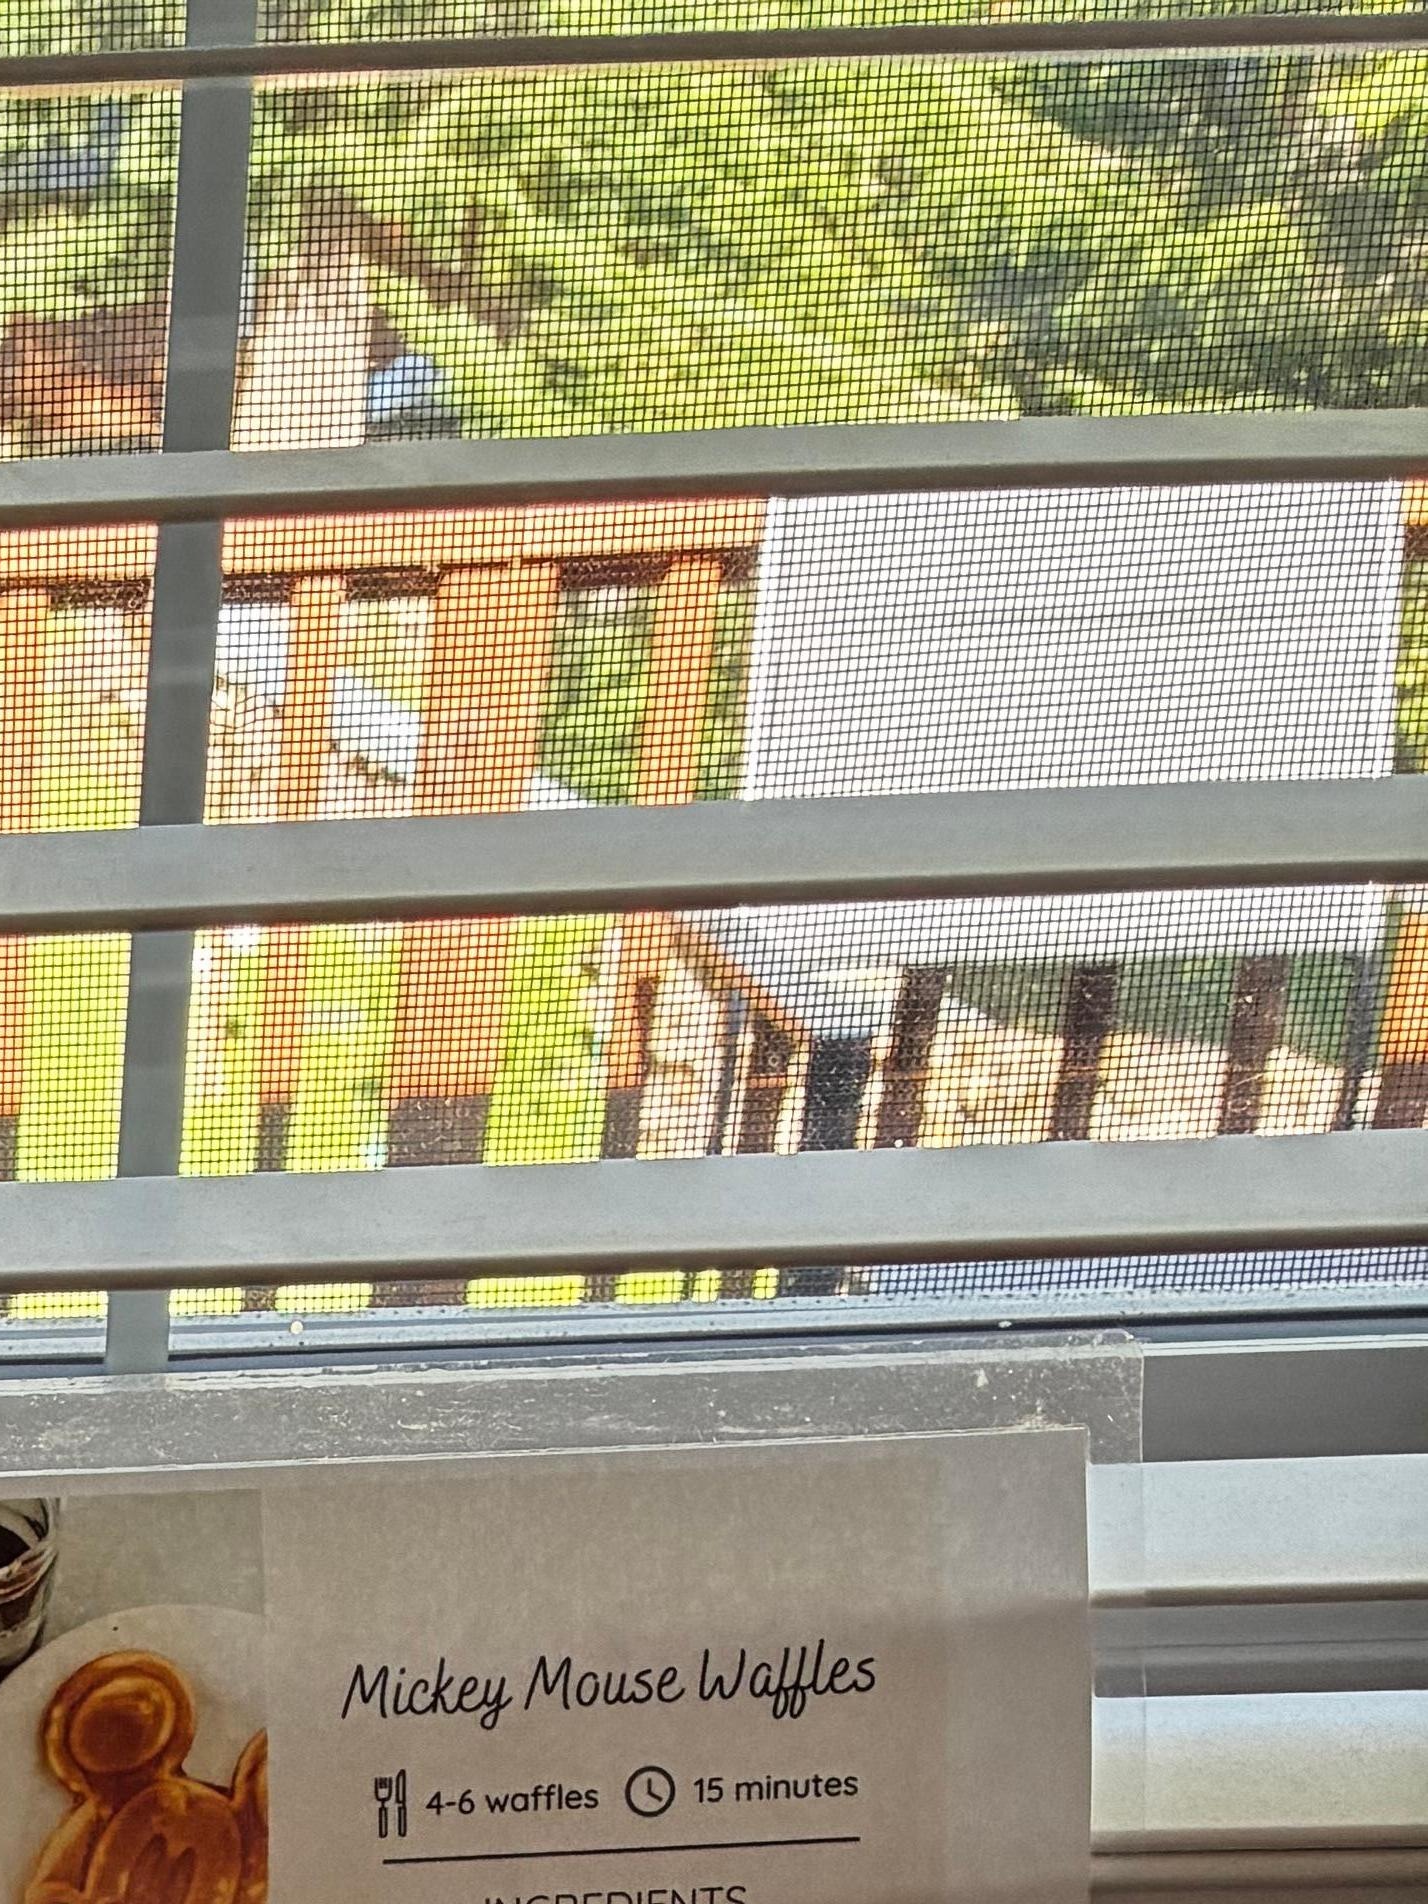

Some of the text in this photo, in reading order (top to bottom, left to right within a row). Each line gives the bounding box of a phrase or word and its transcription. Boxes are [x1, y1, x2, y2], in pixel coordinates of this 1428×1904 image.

[340, 1637, 876, 1732] Mickey Mouse Waffles
[424, 1783, 600, 1817] 4-6 waffles
[693, 1773, 859, 1804] 15 minutes
